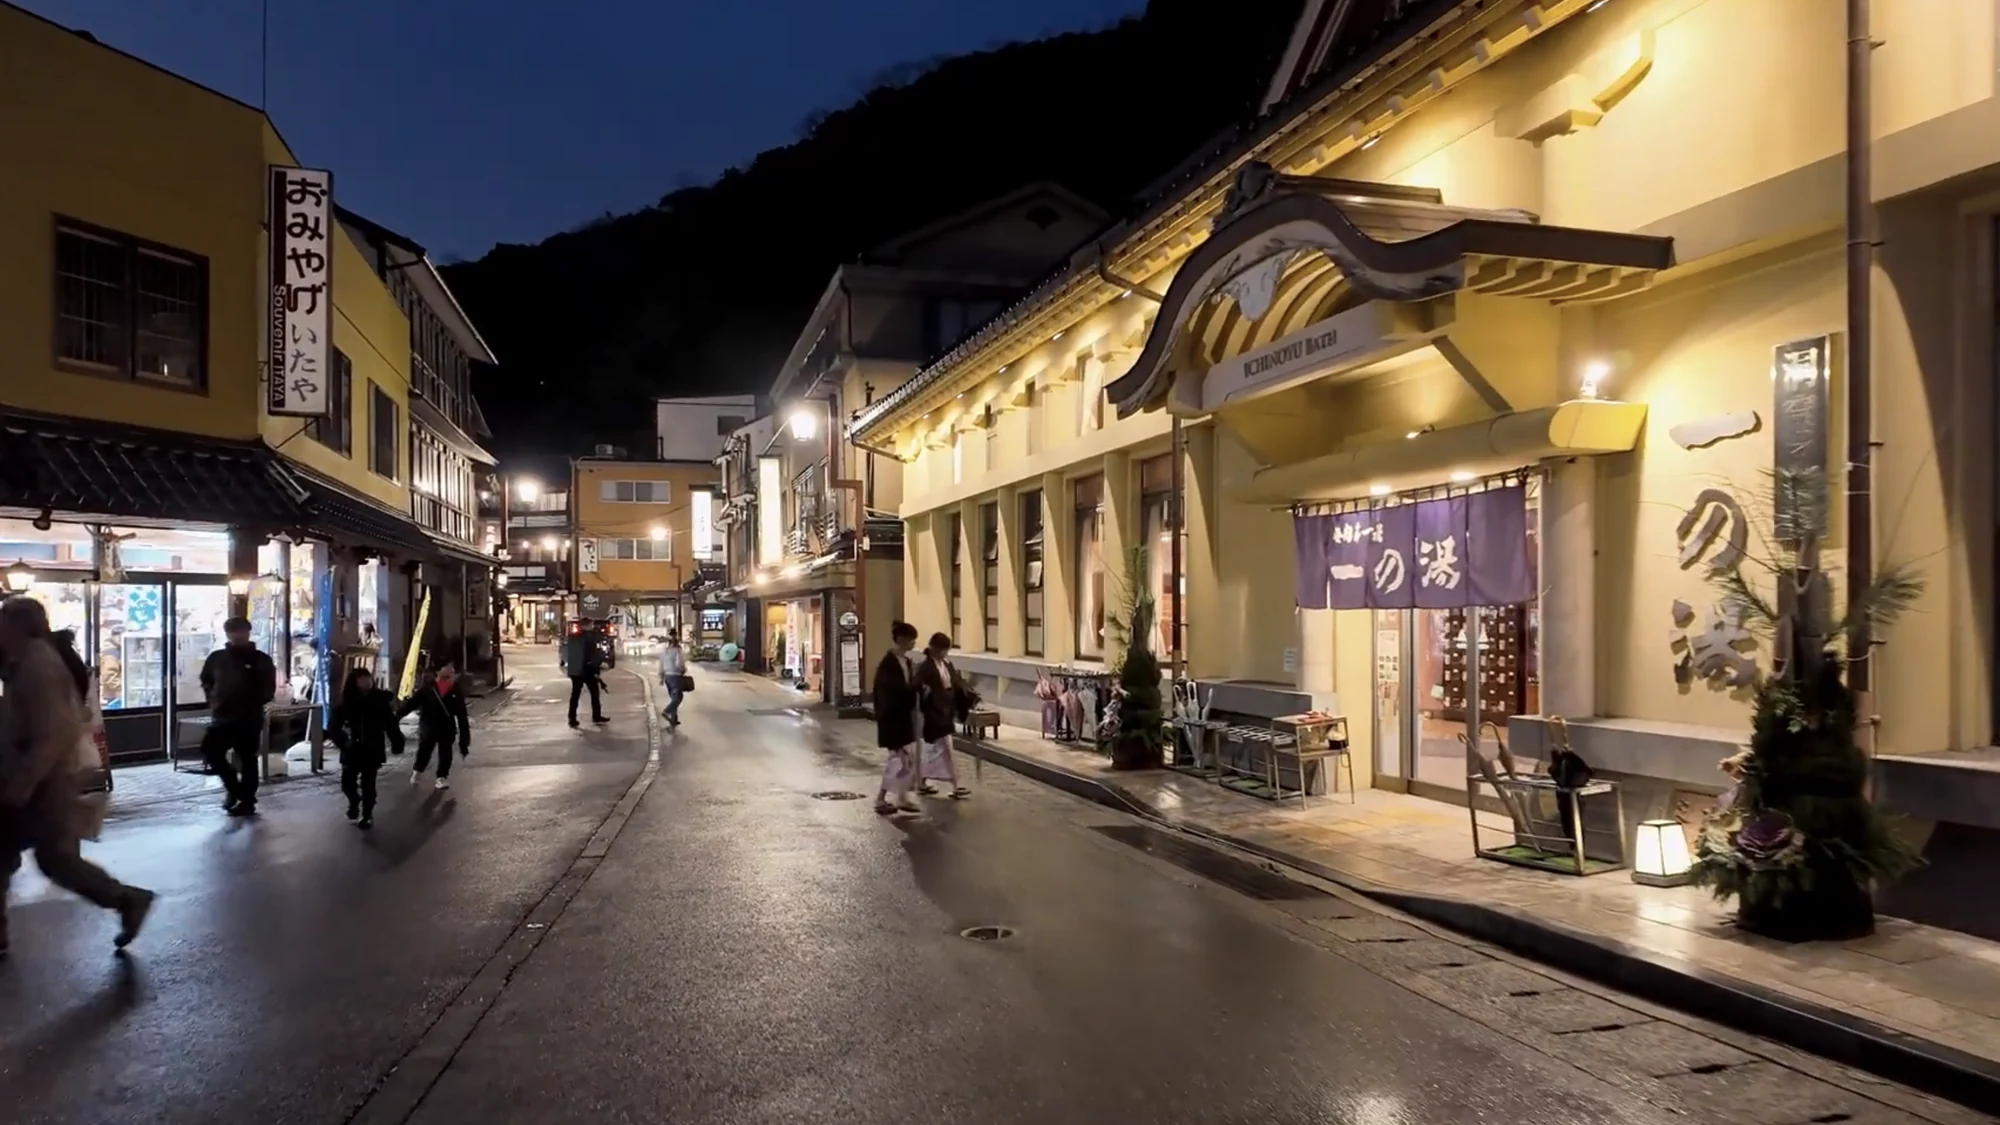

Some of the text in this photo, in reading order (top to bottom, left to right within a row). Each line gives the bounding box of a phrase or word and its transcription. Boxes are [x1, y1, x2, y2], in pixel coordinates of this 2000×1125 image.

[273, 285, 286, 401] Souvenir ITAYA
[1243, 329, 1338, 378] ICHINOYU BATH
[1329, 535, 1462, 594] 一の湯
